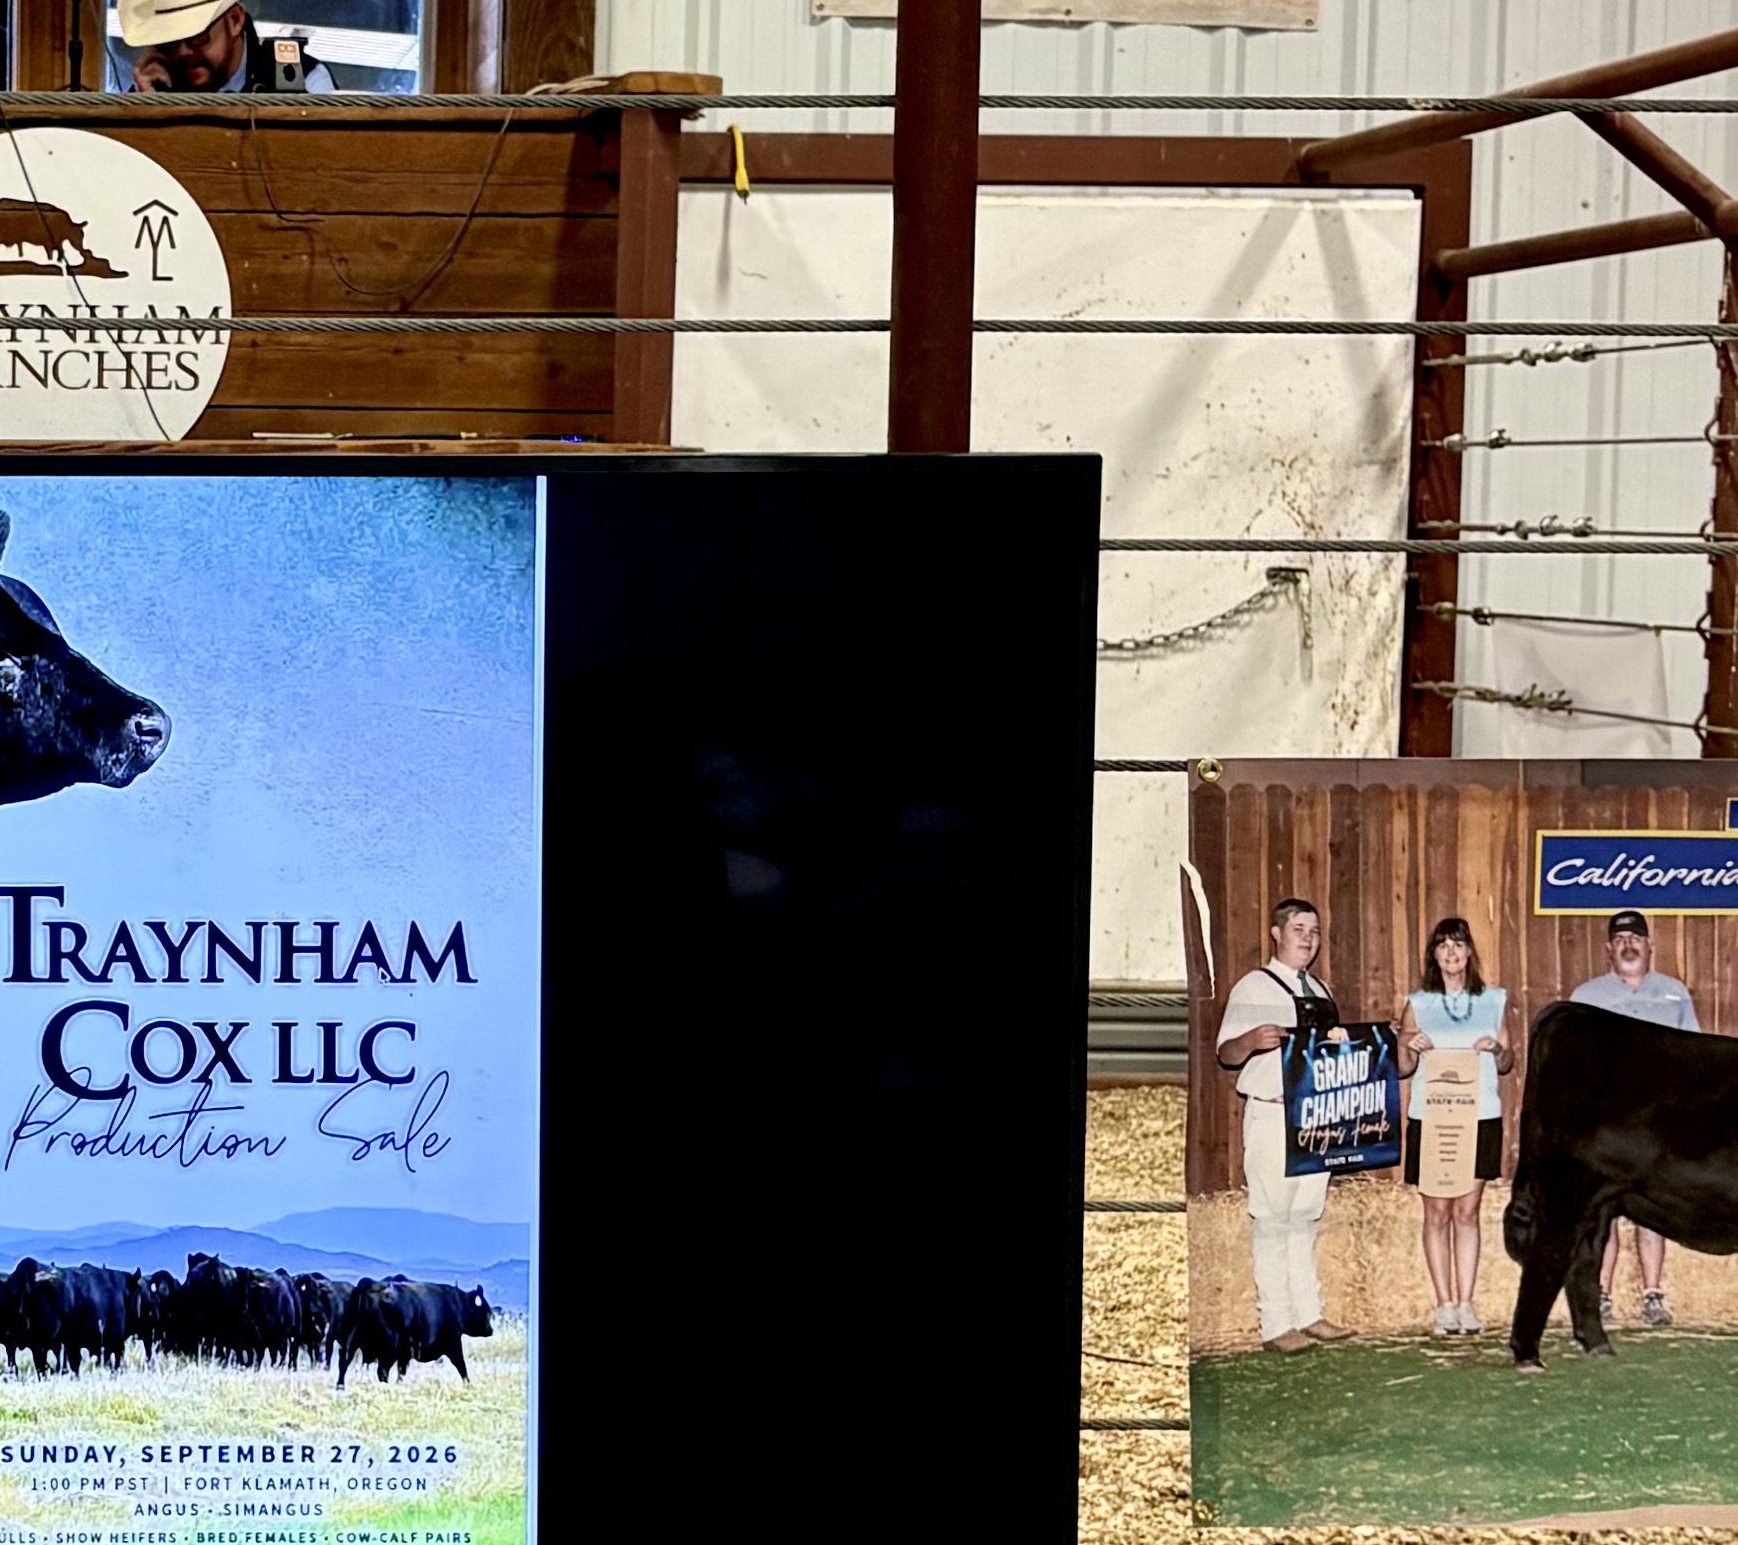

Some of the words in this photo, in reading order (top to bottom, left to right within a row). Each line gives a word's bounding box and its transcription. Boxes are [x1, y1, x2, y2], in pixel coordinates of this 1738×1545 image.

[41, 999, 253, 1100] COX
[271, 1020, 417, 1084] LLC
[1313, 1050, 1370, 1092] GRAND
[5, 1067, 286, 1171] Production
[318, 1071, 452, 1173] Sale
[1301, 1079, 1387, 1129] CHAMPION
[0, 1445, 126, 1468] SUNDAY,
[141, 1445, 315, 1463] SEPTEMBER
[330, 1445, 374, 1468] 27,
[388, 1445, 458, 1463] 2026
[31, 1477, 71, 1491] 1:00
[80, 1477, 106, 1491] PM
[115, 1477, 149, 1491] PST
[185, 1477, 233, 1491] FORT
[242, 1477, 338, 1493] KLAMATH,
[347, 1477, 427, 1491] OREGON
[134, 1503, 199, 1516] ANGUS
[223, 1503, 324, 1516] SIMANGUS
[56, 1532, 103, 1544] SHOW
[110, 1532, 177, 1544] HEIFERS
[197, 1532, 238, 1543] BRED
[245, 1532, 317, 1543] FEMALES
[335, 1532, 418, 1543] COW-CALF
[425, 1532, 472, 1544] PAIRS
